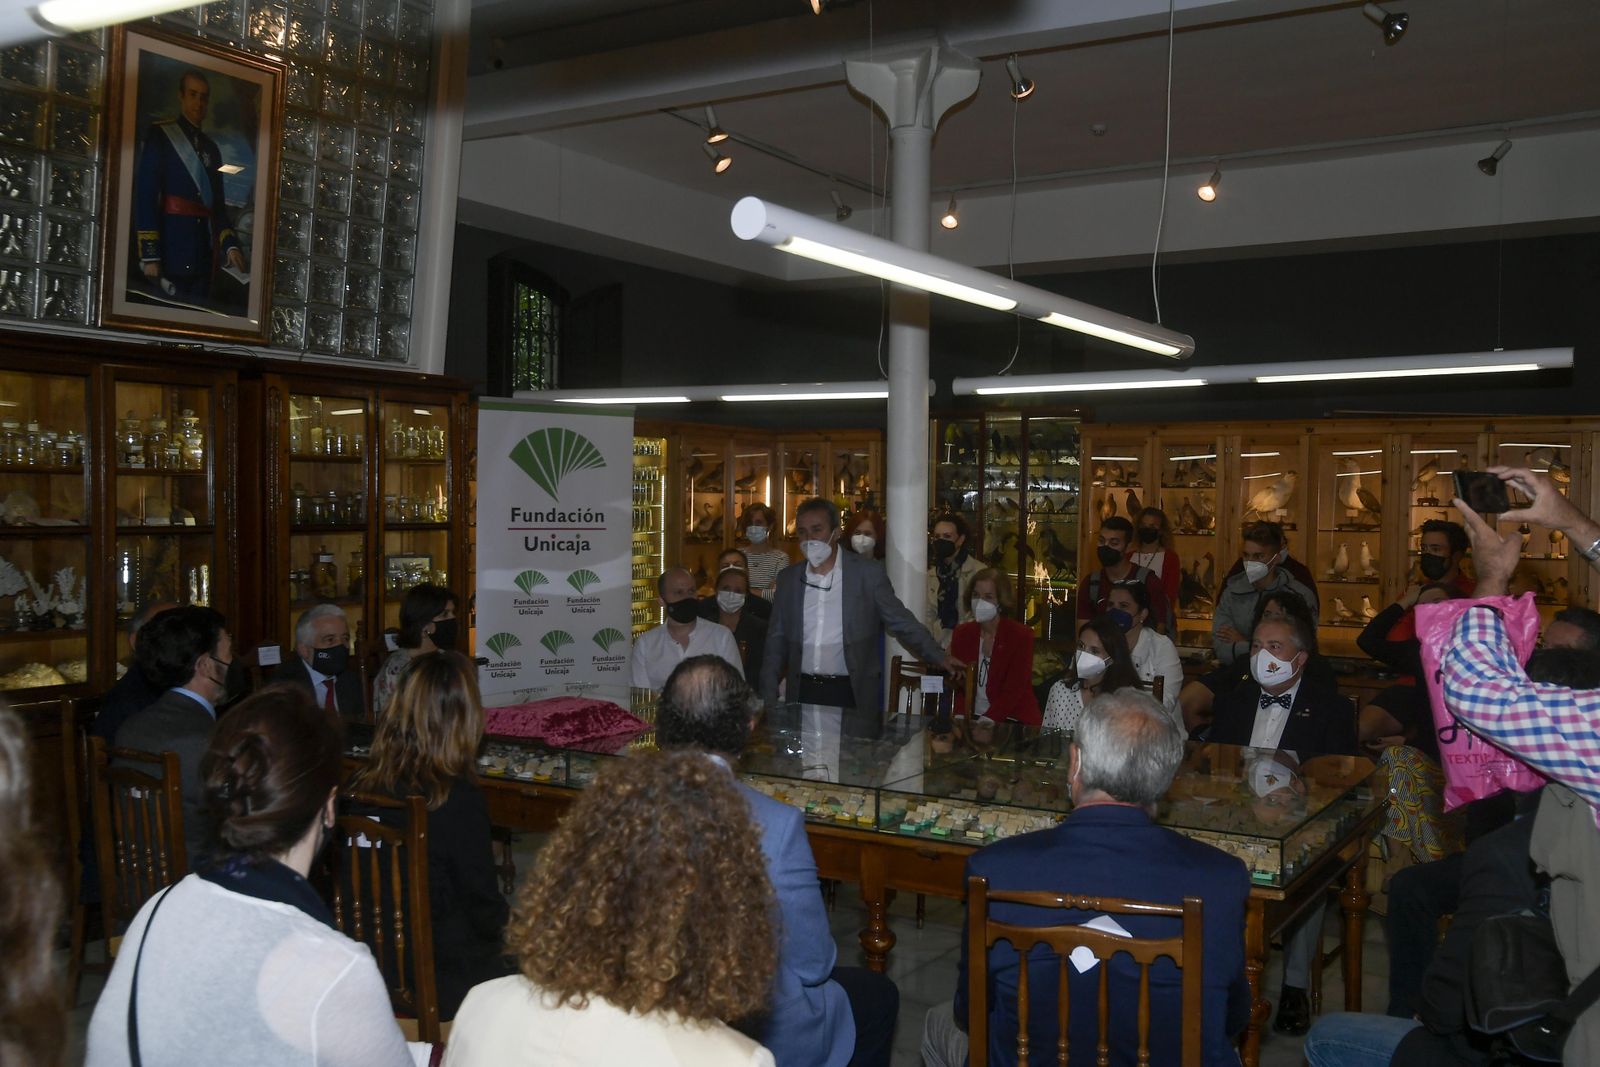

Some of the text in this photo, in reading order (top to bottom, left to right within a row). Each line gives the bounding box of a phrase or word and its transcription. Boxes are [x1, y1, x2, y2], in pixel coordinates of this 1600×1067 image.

[511, 507, 605, 523] Fundación
[524, 534, 591, 555] Unicaja
[513, 598, 549, 606] Fundación
[518, 607, 544, 616] Unicaja
[571, 605, 596, 615] Unicaja
[545, 666, 570, 676] Unicaja
[597, 664, 621, 672] Unicaja
[491, 670, 517, 679] Unicaja
